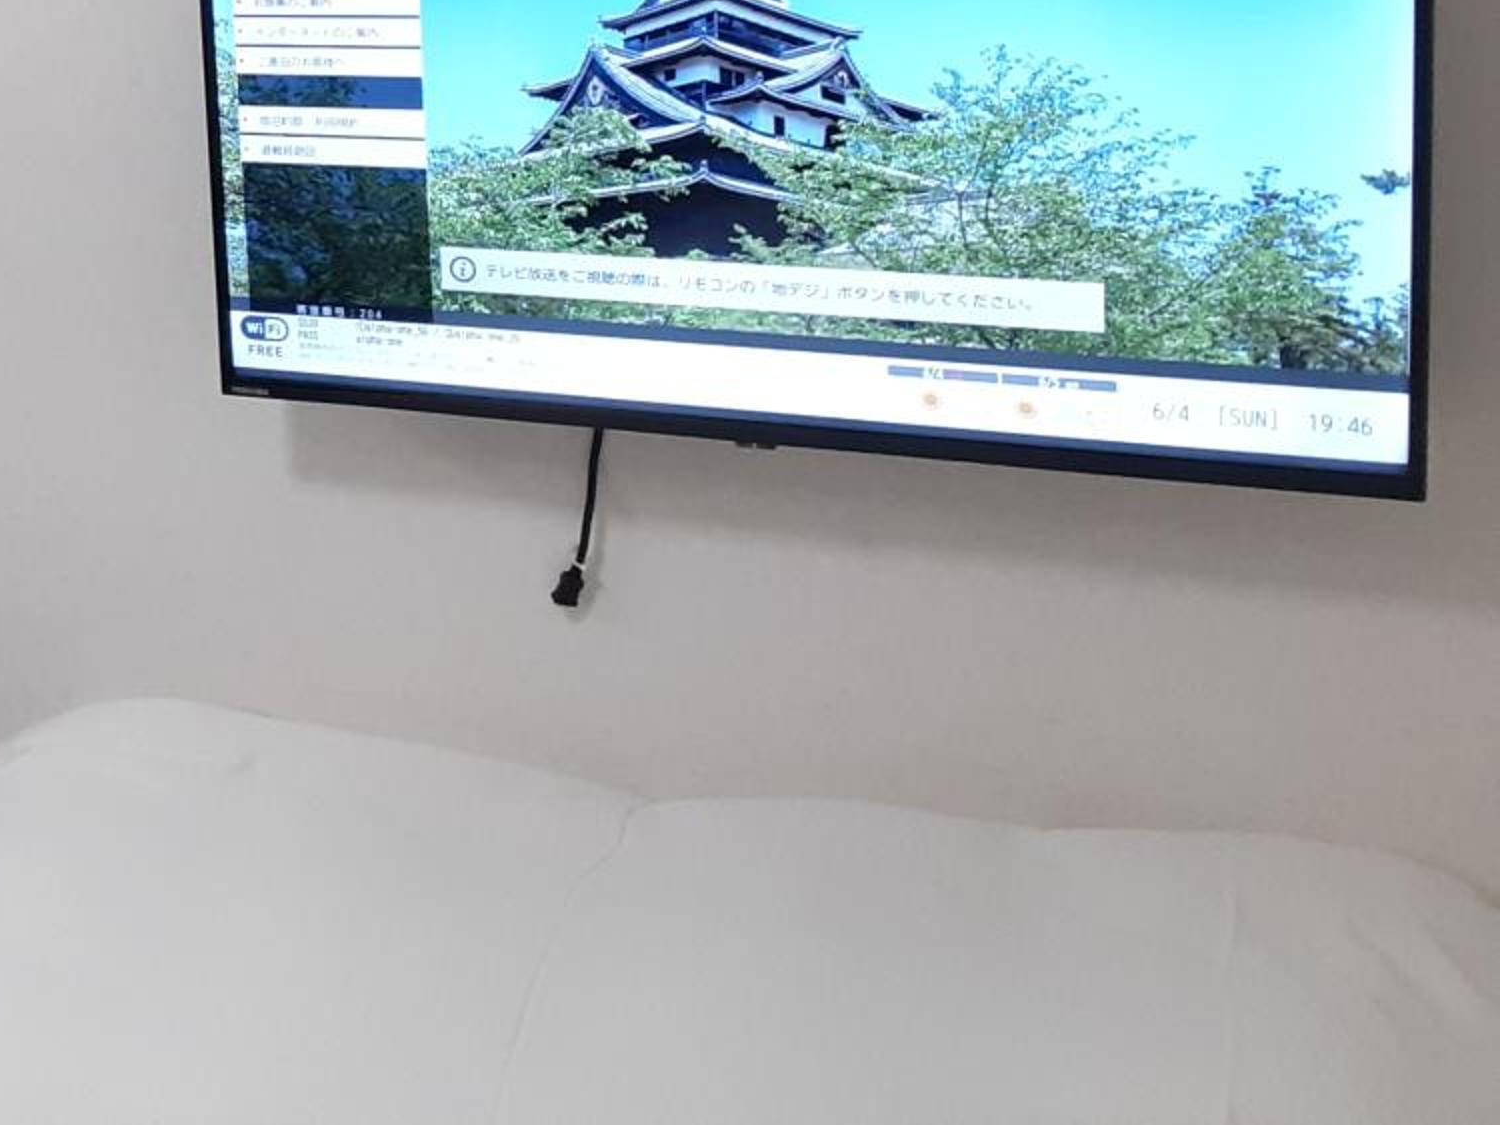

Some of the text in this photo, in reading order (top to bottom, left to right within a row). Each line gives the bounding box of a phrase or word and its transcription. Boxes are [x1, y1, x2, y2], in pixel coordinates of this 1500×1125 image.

[248, 344, 284, 358] FREE
[1152, 402, 1190, 422] 6/4
[1308, 412, 1374, 437] 19:46
